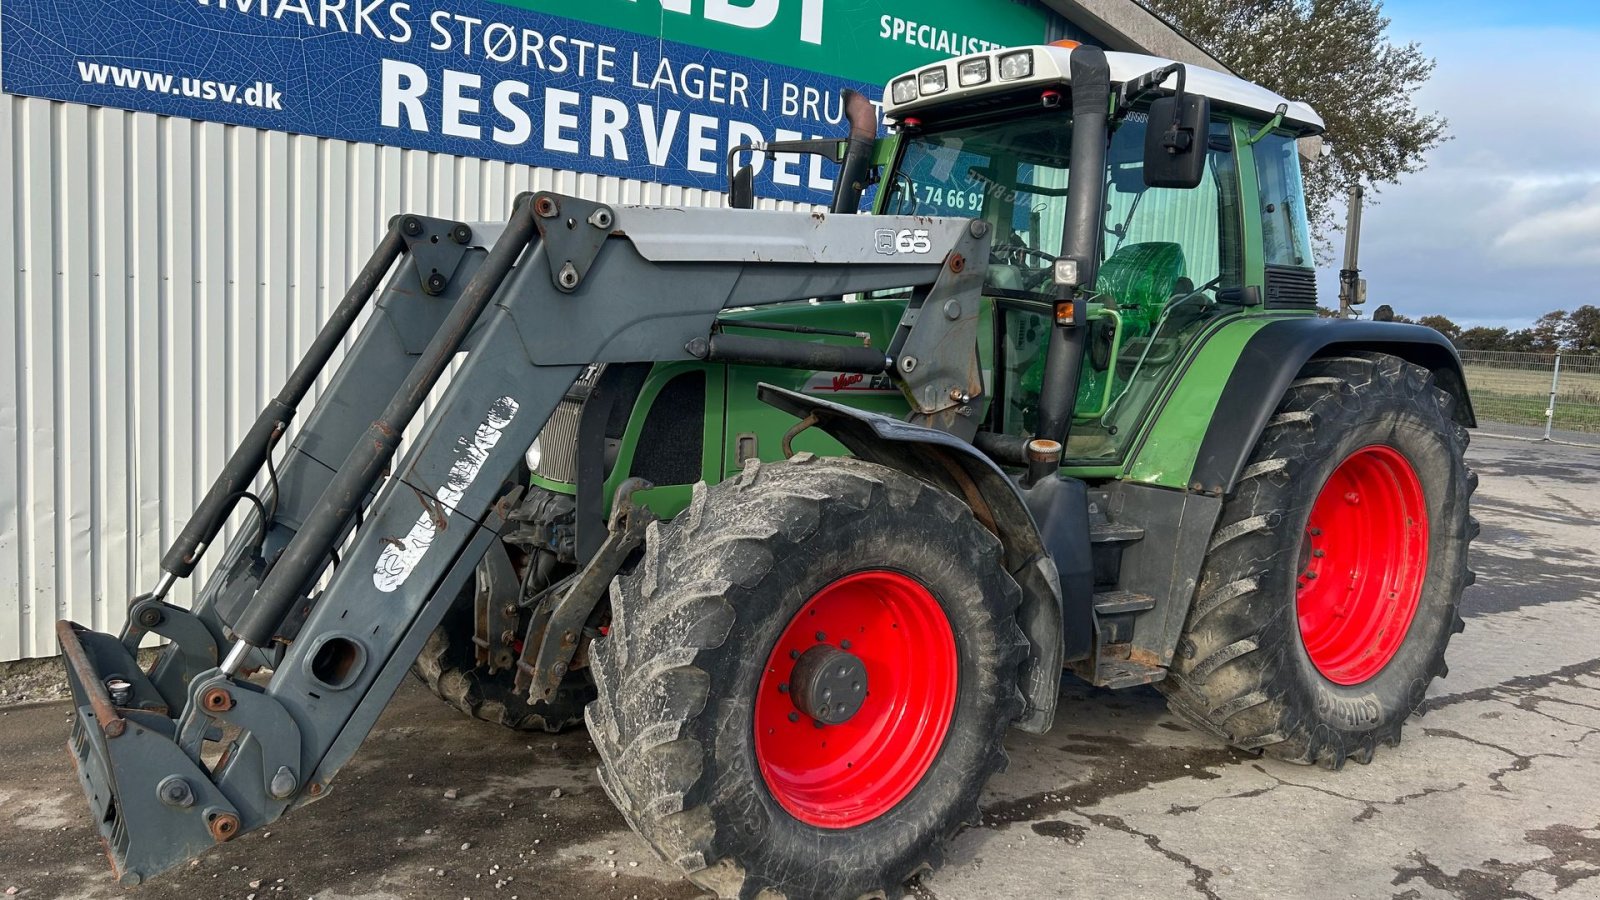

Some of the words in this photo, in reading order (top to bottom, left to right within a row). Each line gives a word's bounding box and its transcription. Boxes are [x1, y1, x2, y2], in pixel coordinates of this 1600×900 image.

[430, 11, 616, 83] STØRSTE
[632, 51, 749, 108] LAGER
[762, 78, 769, 111] I
[77, 61, 283, 110] www.usv.dk
[925, 186, 943, 206] 74
[947, 190, 965, 209] 66
[968, 192, 984, 211] 92
[875, 229, 931, 254] Q65
